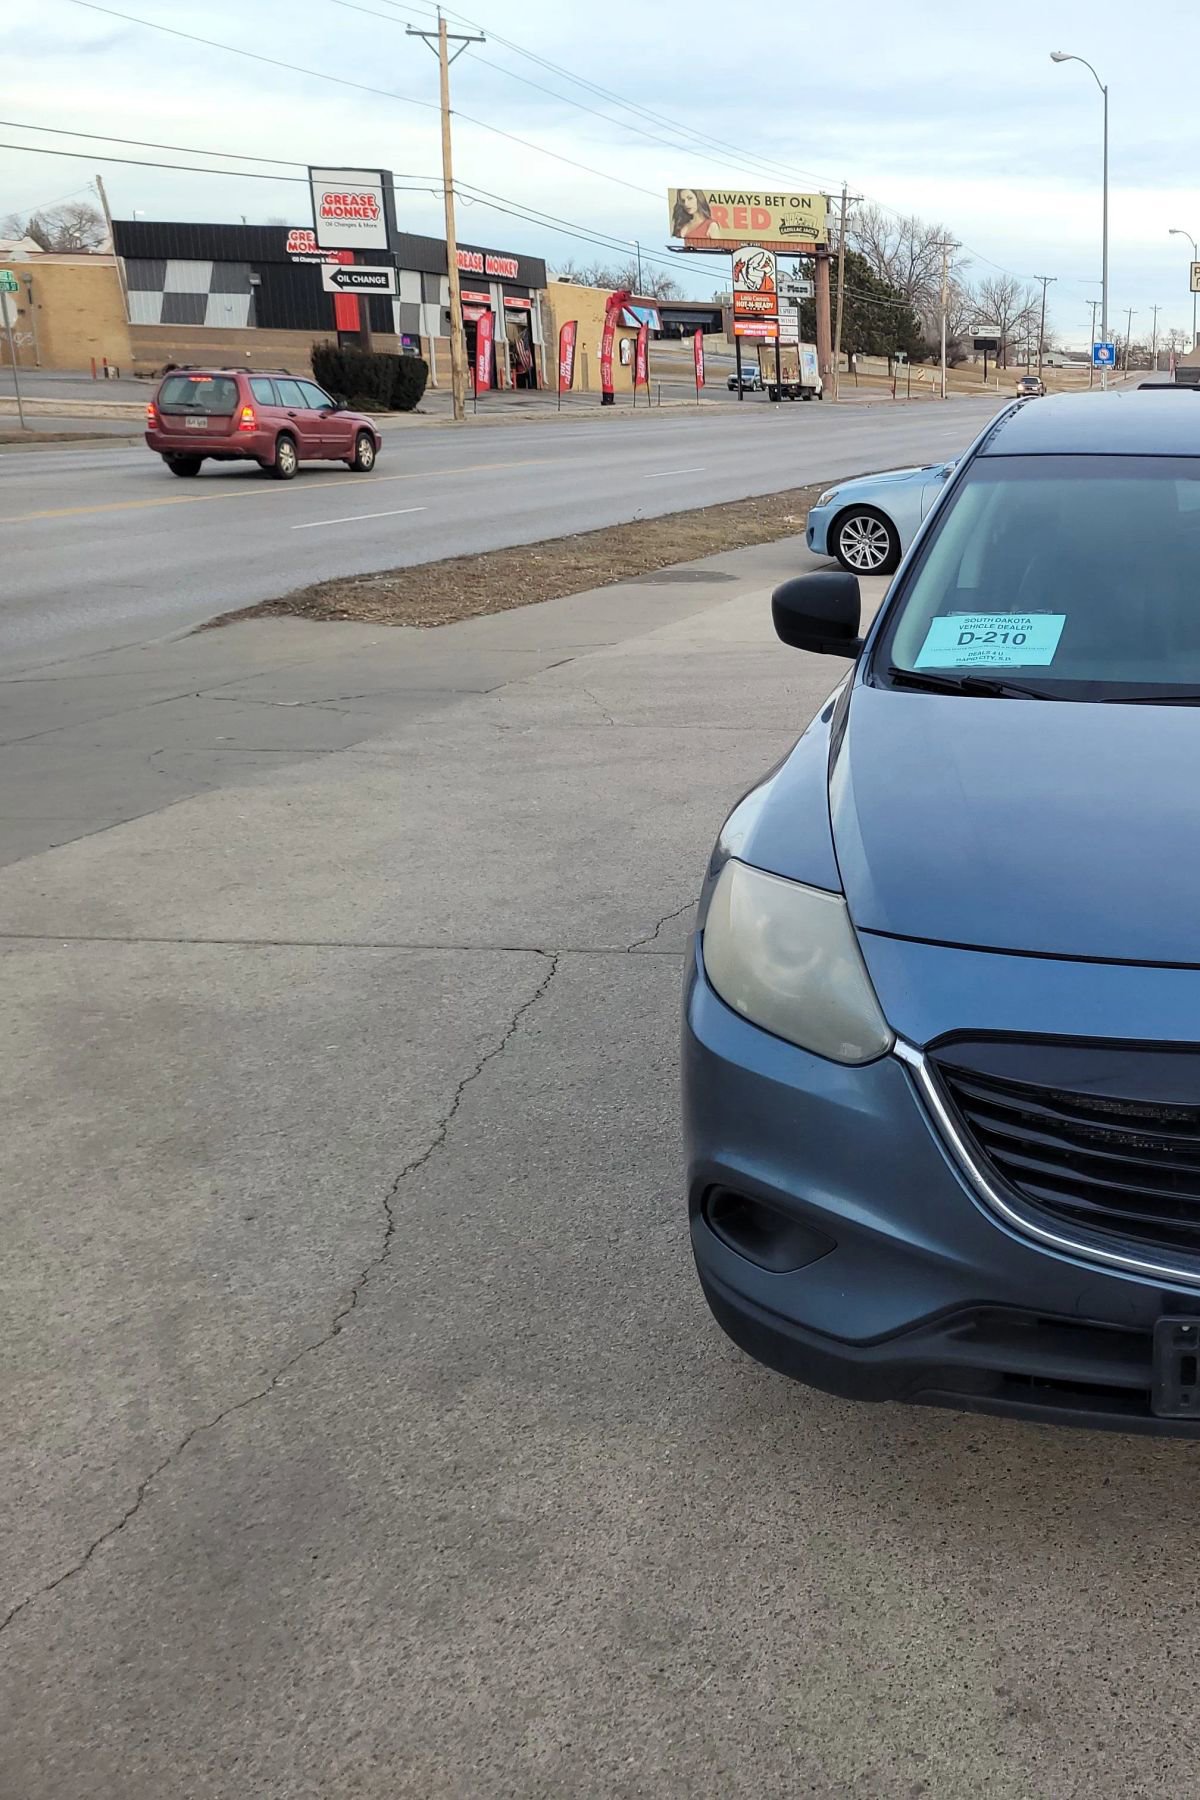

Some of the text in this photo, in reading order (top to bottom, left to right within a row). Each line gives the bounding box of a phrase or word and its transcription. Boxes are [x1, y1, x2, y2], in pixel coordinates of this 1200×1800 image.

[324, 194, 375, 207] GREASE
[708, 193, 812, 208] ALWAYS BET ON
[321, 206, 379, 219] MONKEY
[711, 206, 772, 231] RED
[289, 231, 314, 242] GRE
[456, 250, 518, 278] REASE MONKEY
[337, 274, 387, 284] OIL CHANGE
[957, 631, 1027, 646] D-210
